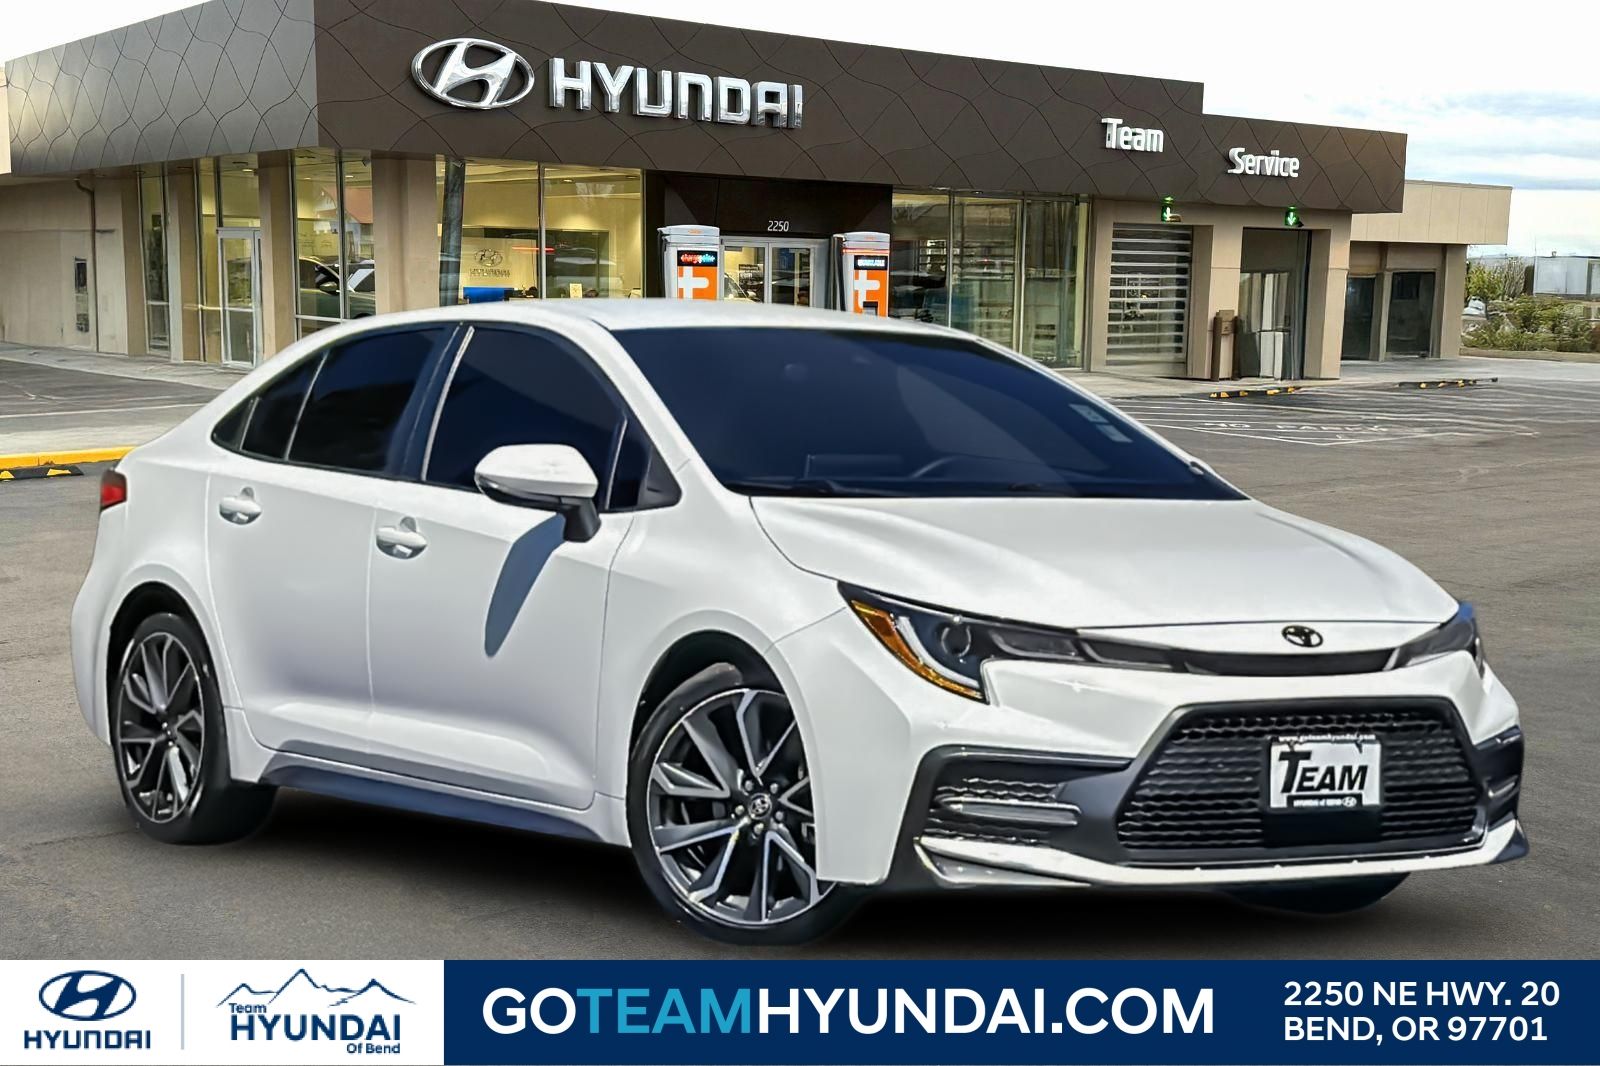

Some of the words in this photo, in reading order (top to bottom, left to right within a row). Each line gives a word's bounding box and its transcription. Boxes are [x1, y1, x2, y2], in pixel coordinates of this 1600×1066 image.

[549, 57, 803, 129] HYUNDAI
[1101, 117, 1164, 152] Team
[1227, 147, 1300, 177] Service
[767, 220, 790, 232] 2250
